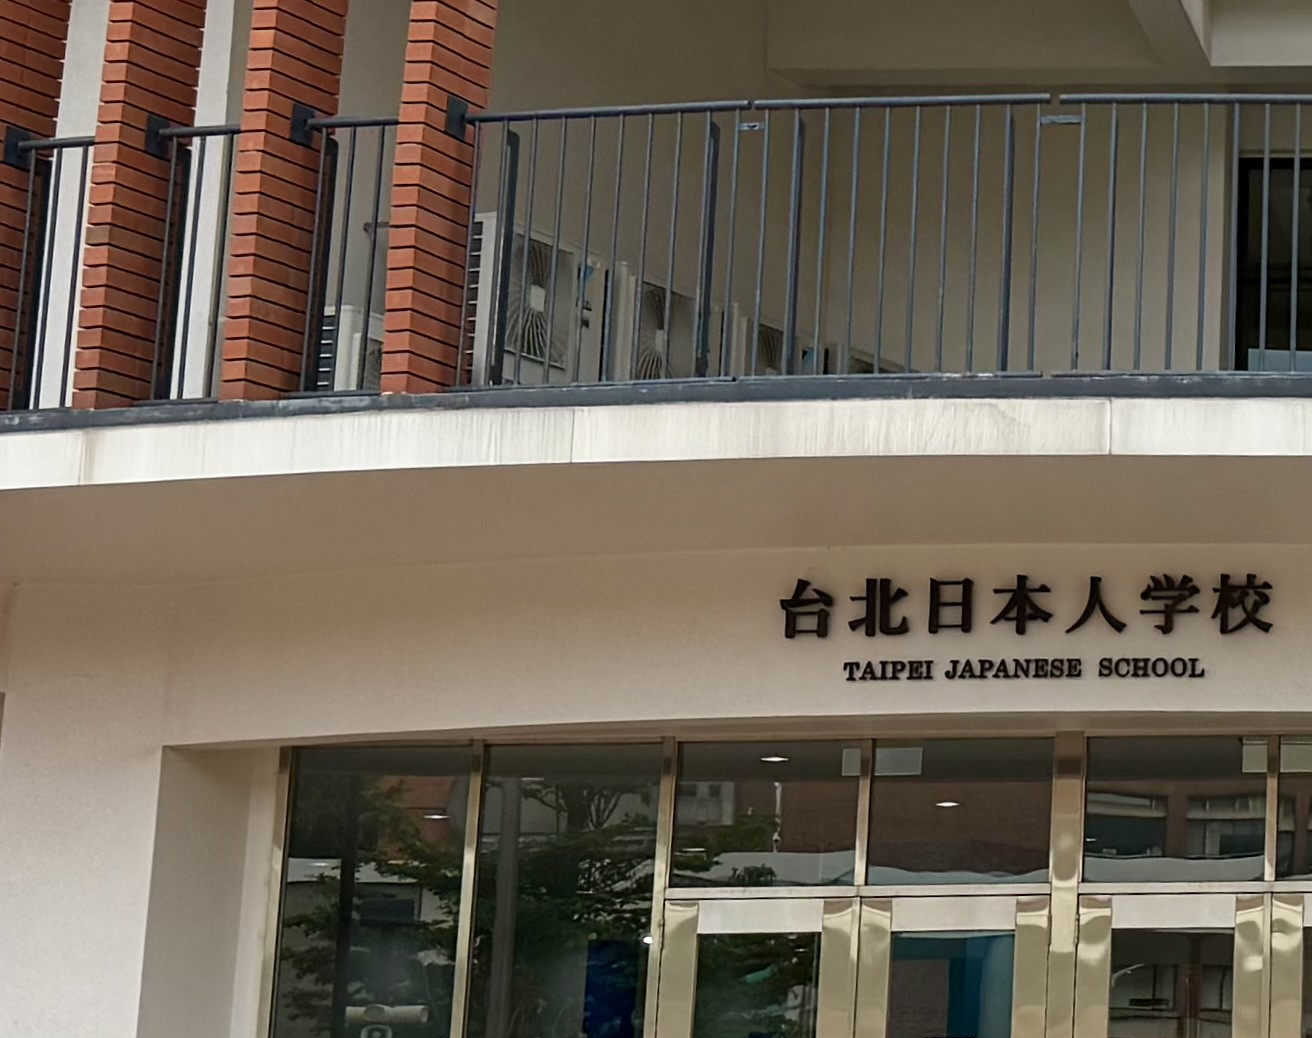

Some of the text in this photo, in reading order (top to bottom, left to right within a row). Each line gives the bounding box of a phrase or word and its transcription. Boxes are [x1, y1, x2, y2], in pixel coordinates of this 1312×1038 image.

[779, 573, 1274, 639] 台北日本人学校
[843, 657, 1205, 682] TAIPEI JAPANESE SCHOOL
